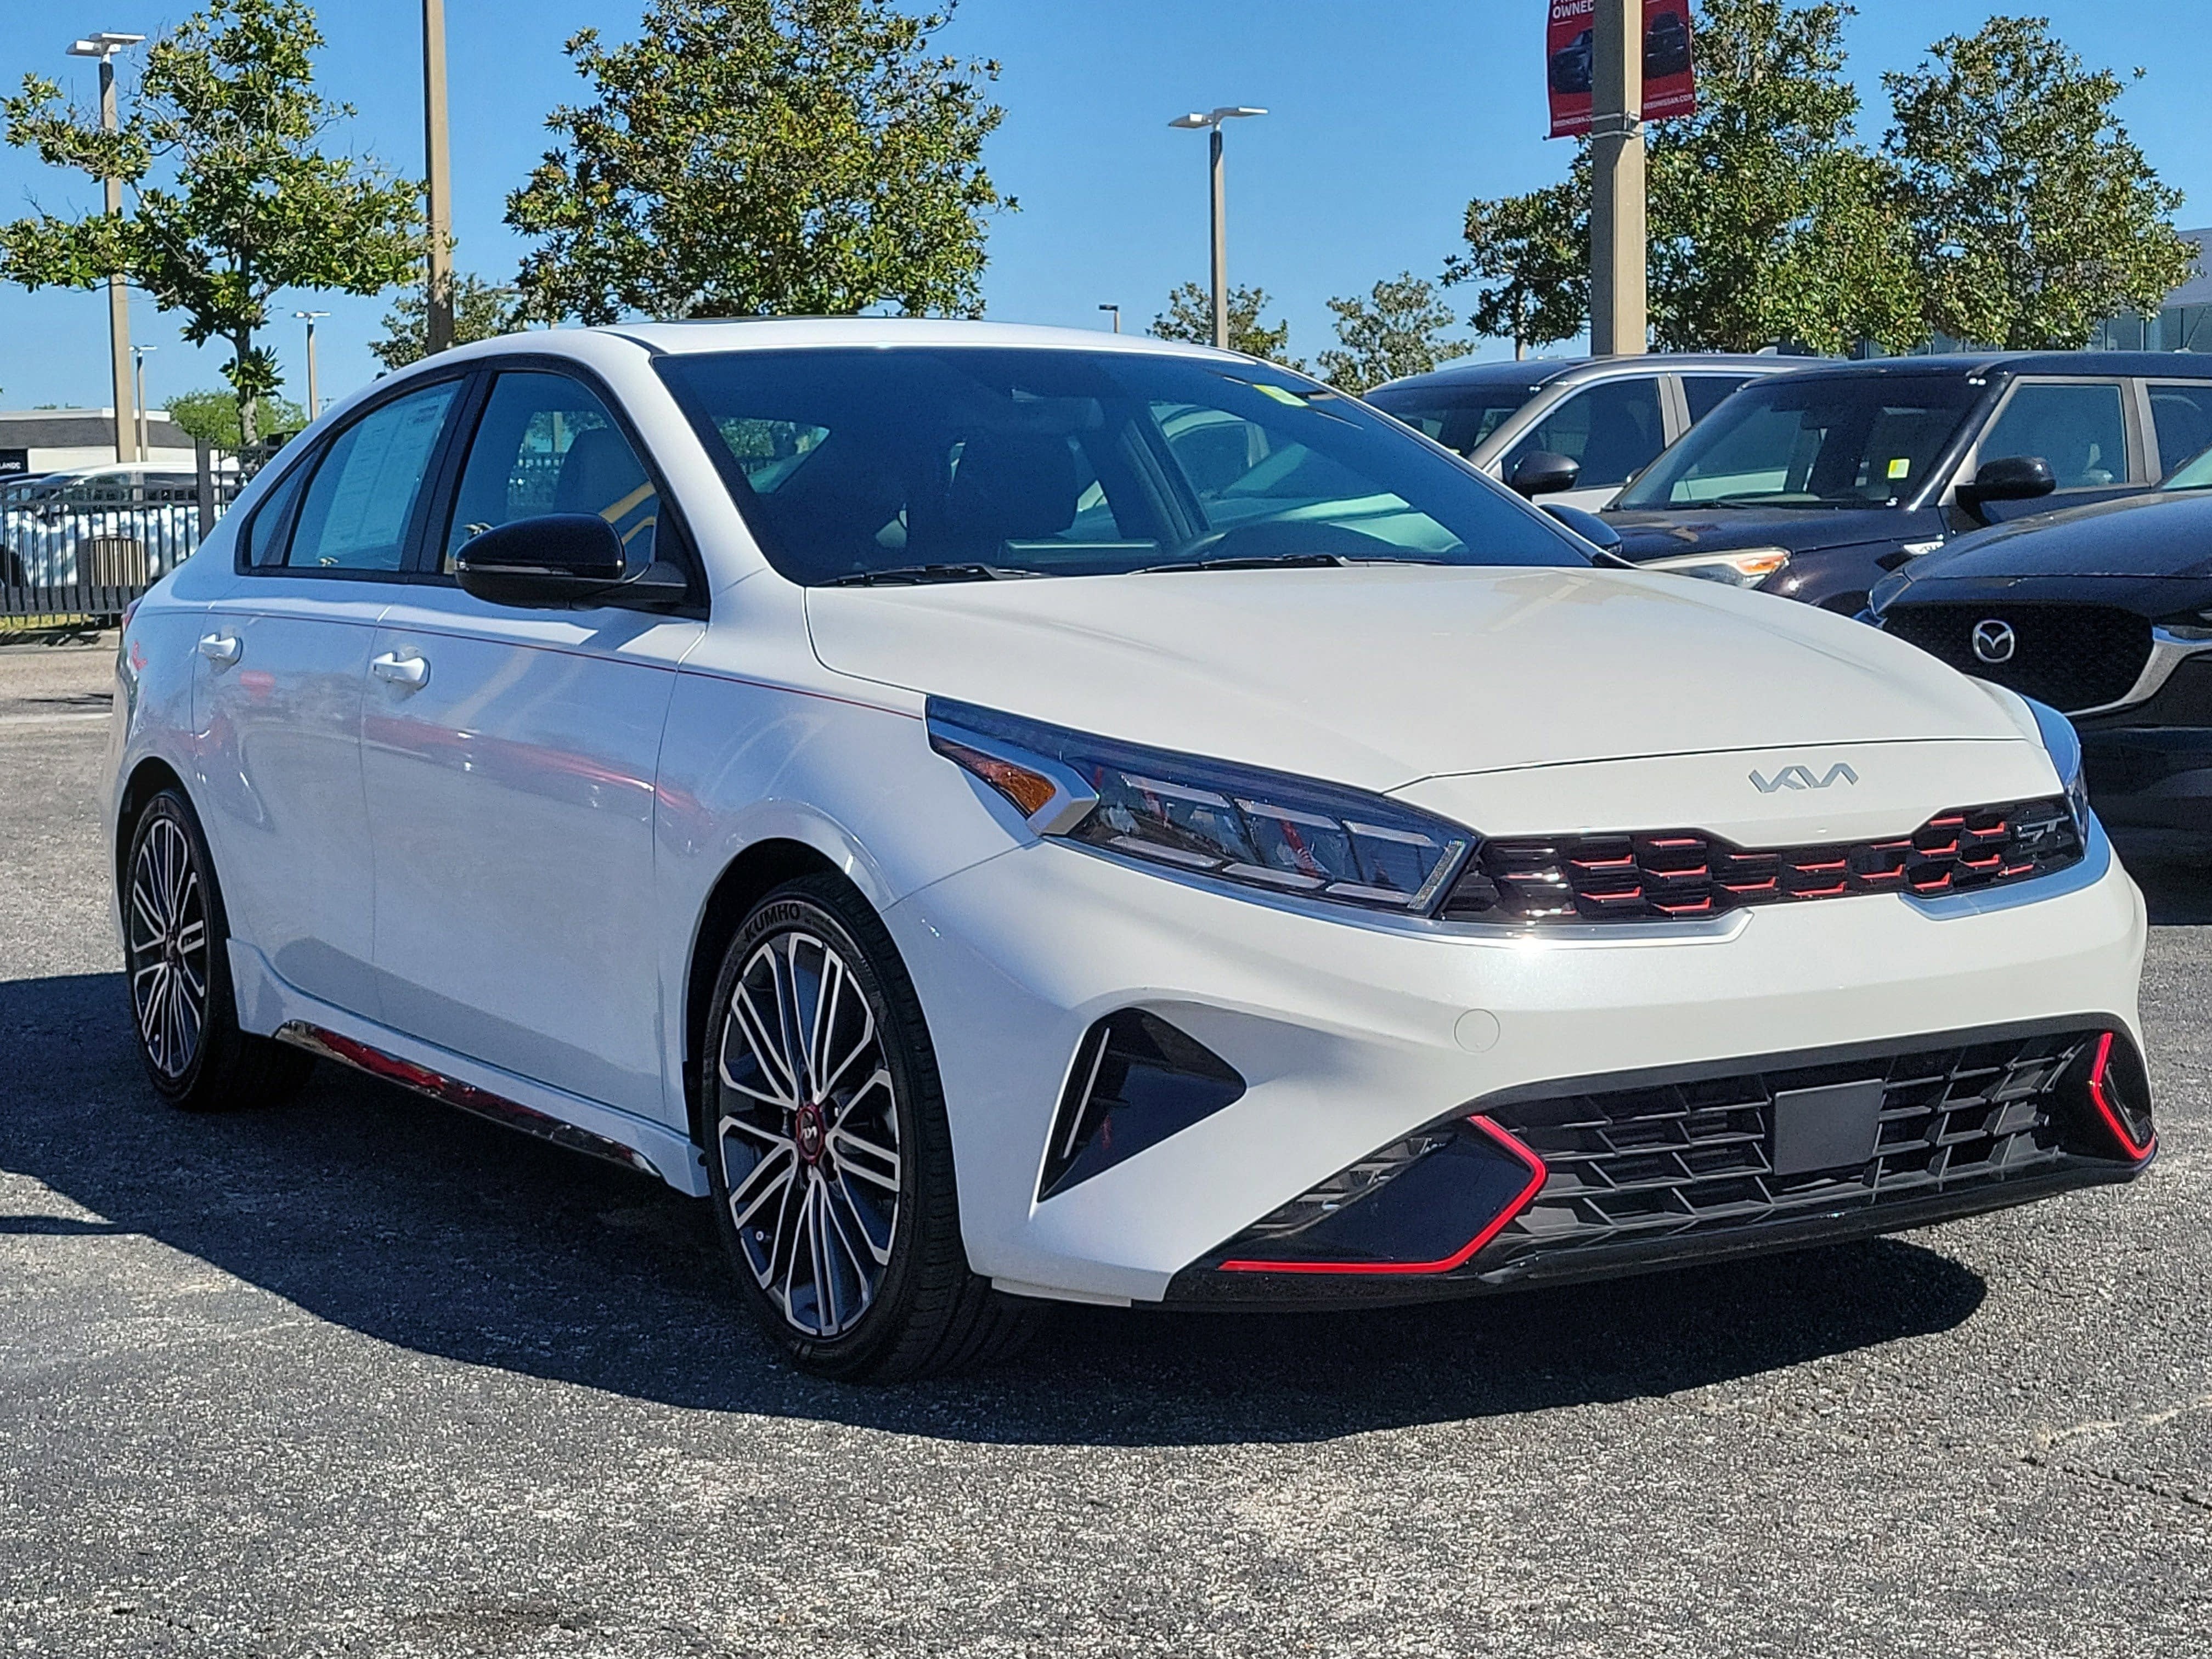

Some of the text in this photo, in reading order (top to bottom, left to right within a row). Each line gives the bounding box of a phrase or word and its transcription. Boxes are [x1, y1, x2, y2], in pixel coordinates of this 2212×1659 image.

[1553, 1, 1594, 19] OWNED
[1748, 763, 1859, 793] KIA
[744, 902, 800, 943] KUMHO
